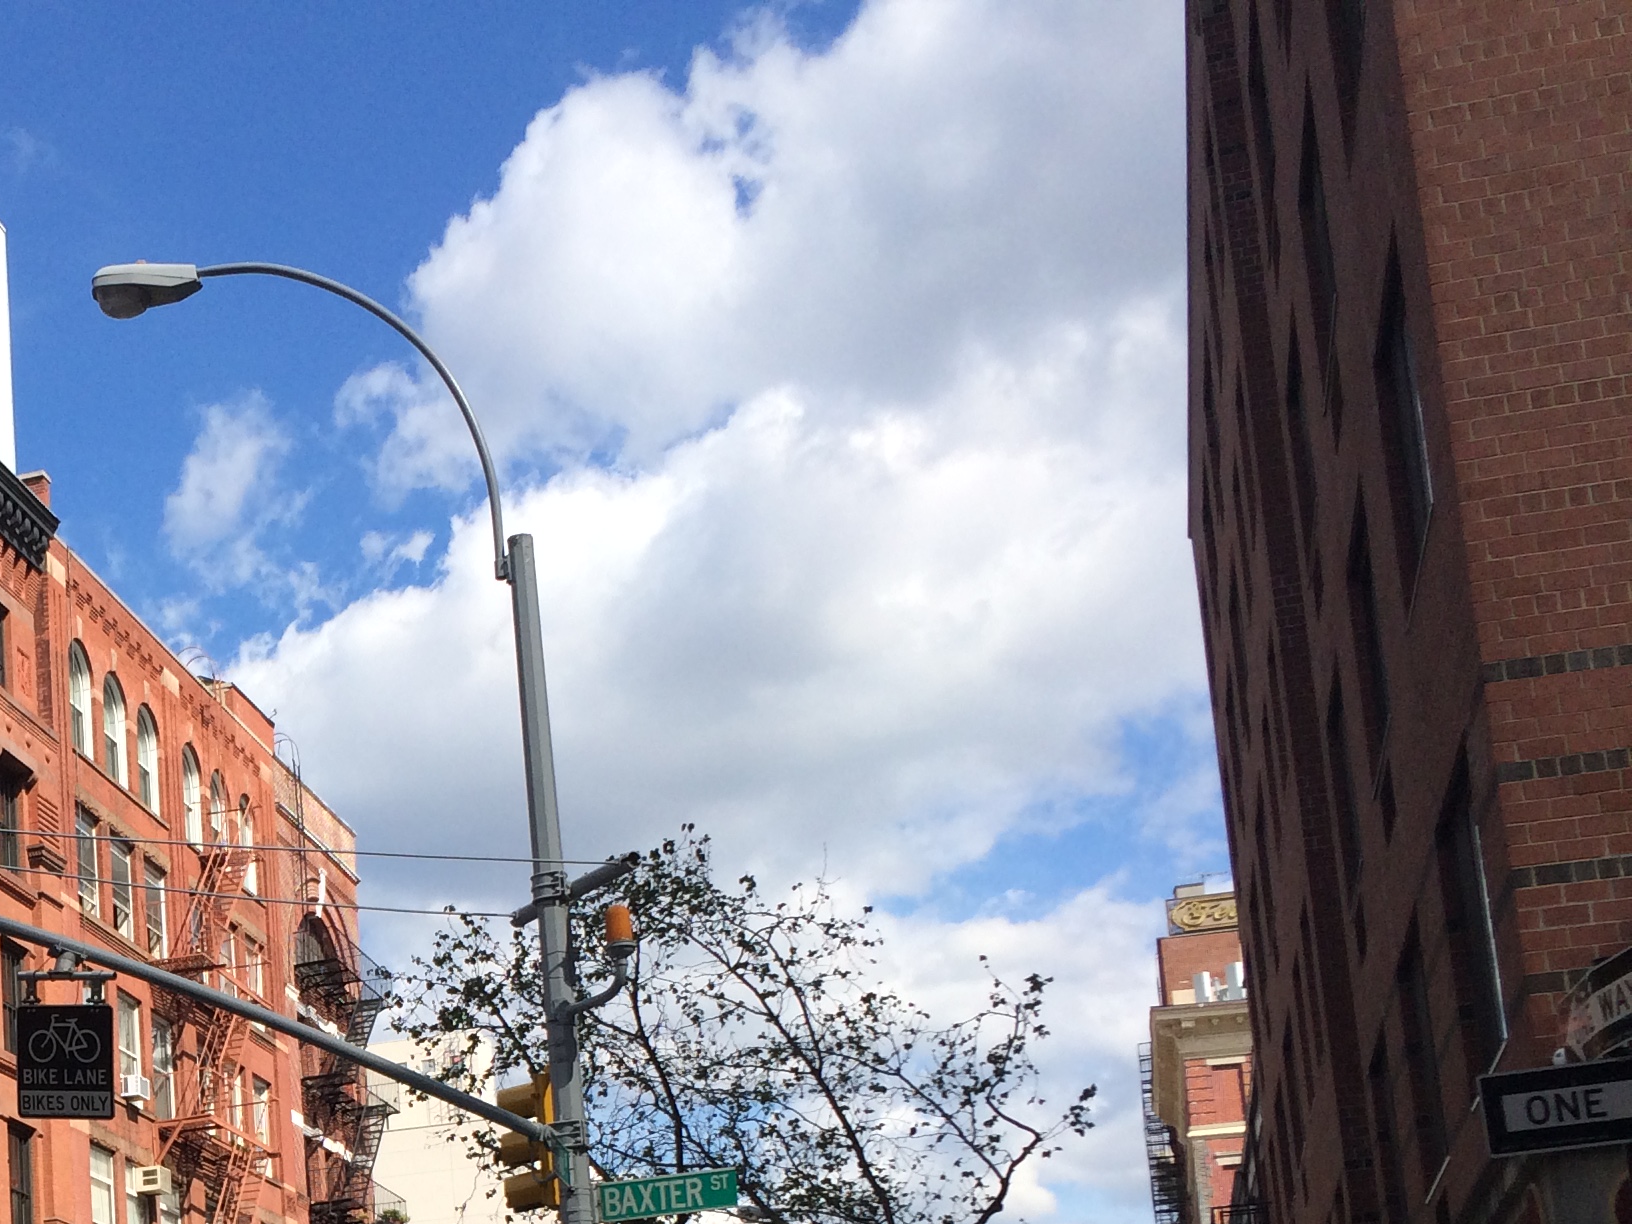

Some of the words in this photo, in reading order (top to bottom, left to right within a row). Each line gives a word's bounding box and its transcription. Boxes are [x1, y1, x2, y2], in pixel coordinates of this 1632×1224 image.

[23, 1068, 59, 1085] BIKE
[64, 1068, 107, 1085] LANE
[22, 1095, 65, 1110] BIKES
[70, 1095, 108, 1111] ONLY
[1526, 1088, 1608, 1125] ONE
[604, 1177, 704, 1217] BAXTER
[710, 1174, 729, 1191] ST
